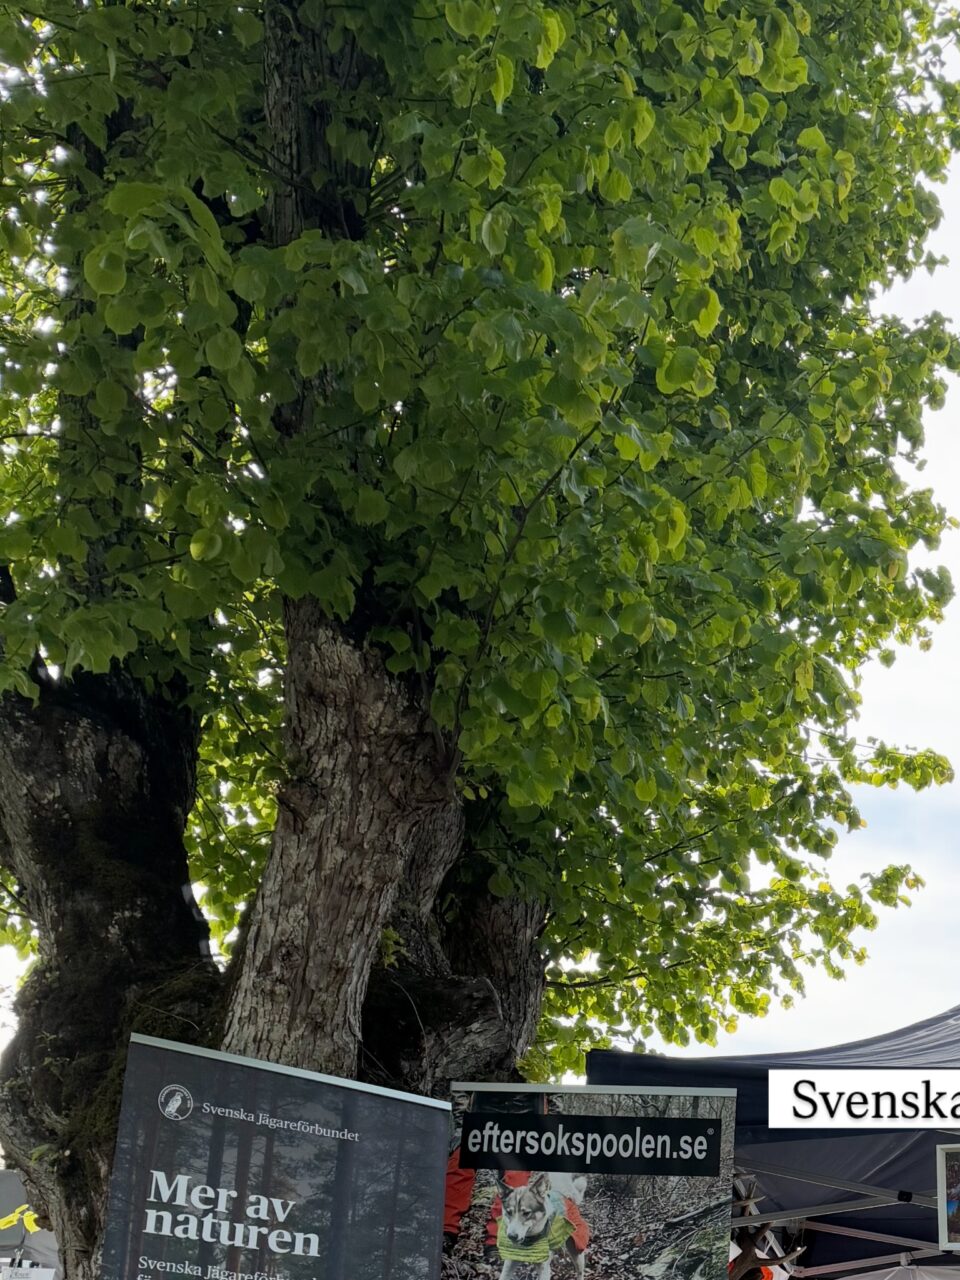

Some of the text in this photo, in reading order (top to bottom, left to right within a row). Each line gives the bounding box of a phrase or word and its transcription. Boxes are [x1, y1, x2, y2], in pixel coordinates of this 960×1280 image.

[201, 1102, 360, 1142] Svenska Jägareförbundet
[467, 1121, 708, 1164] eftersokspoolen.se
[146, 1170, 296, 1222] Mer av
[142, 1208, 321, 1257] naturen
[138, 1255, 202, 1277] Svenska
